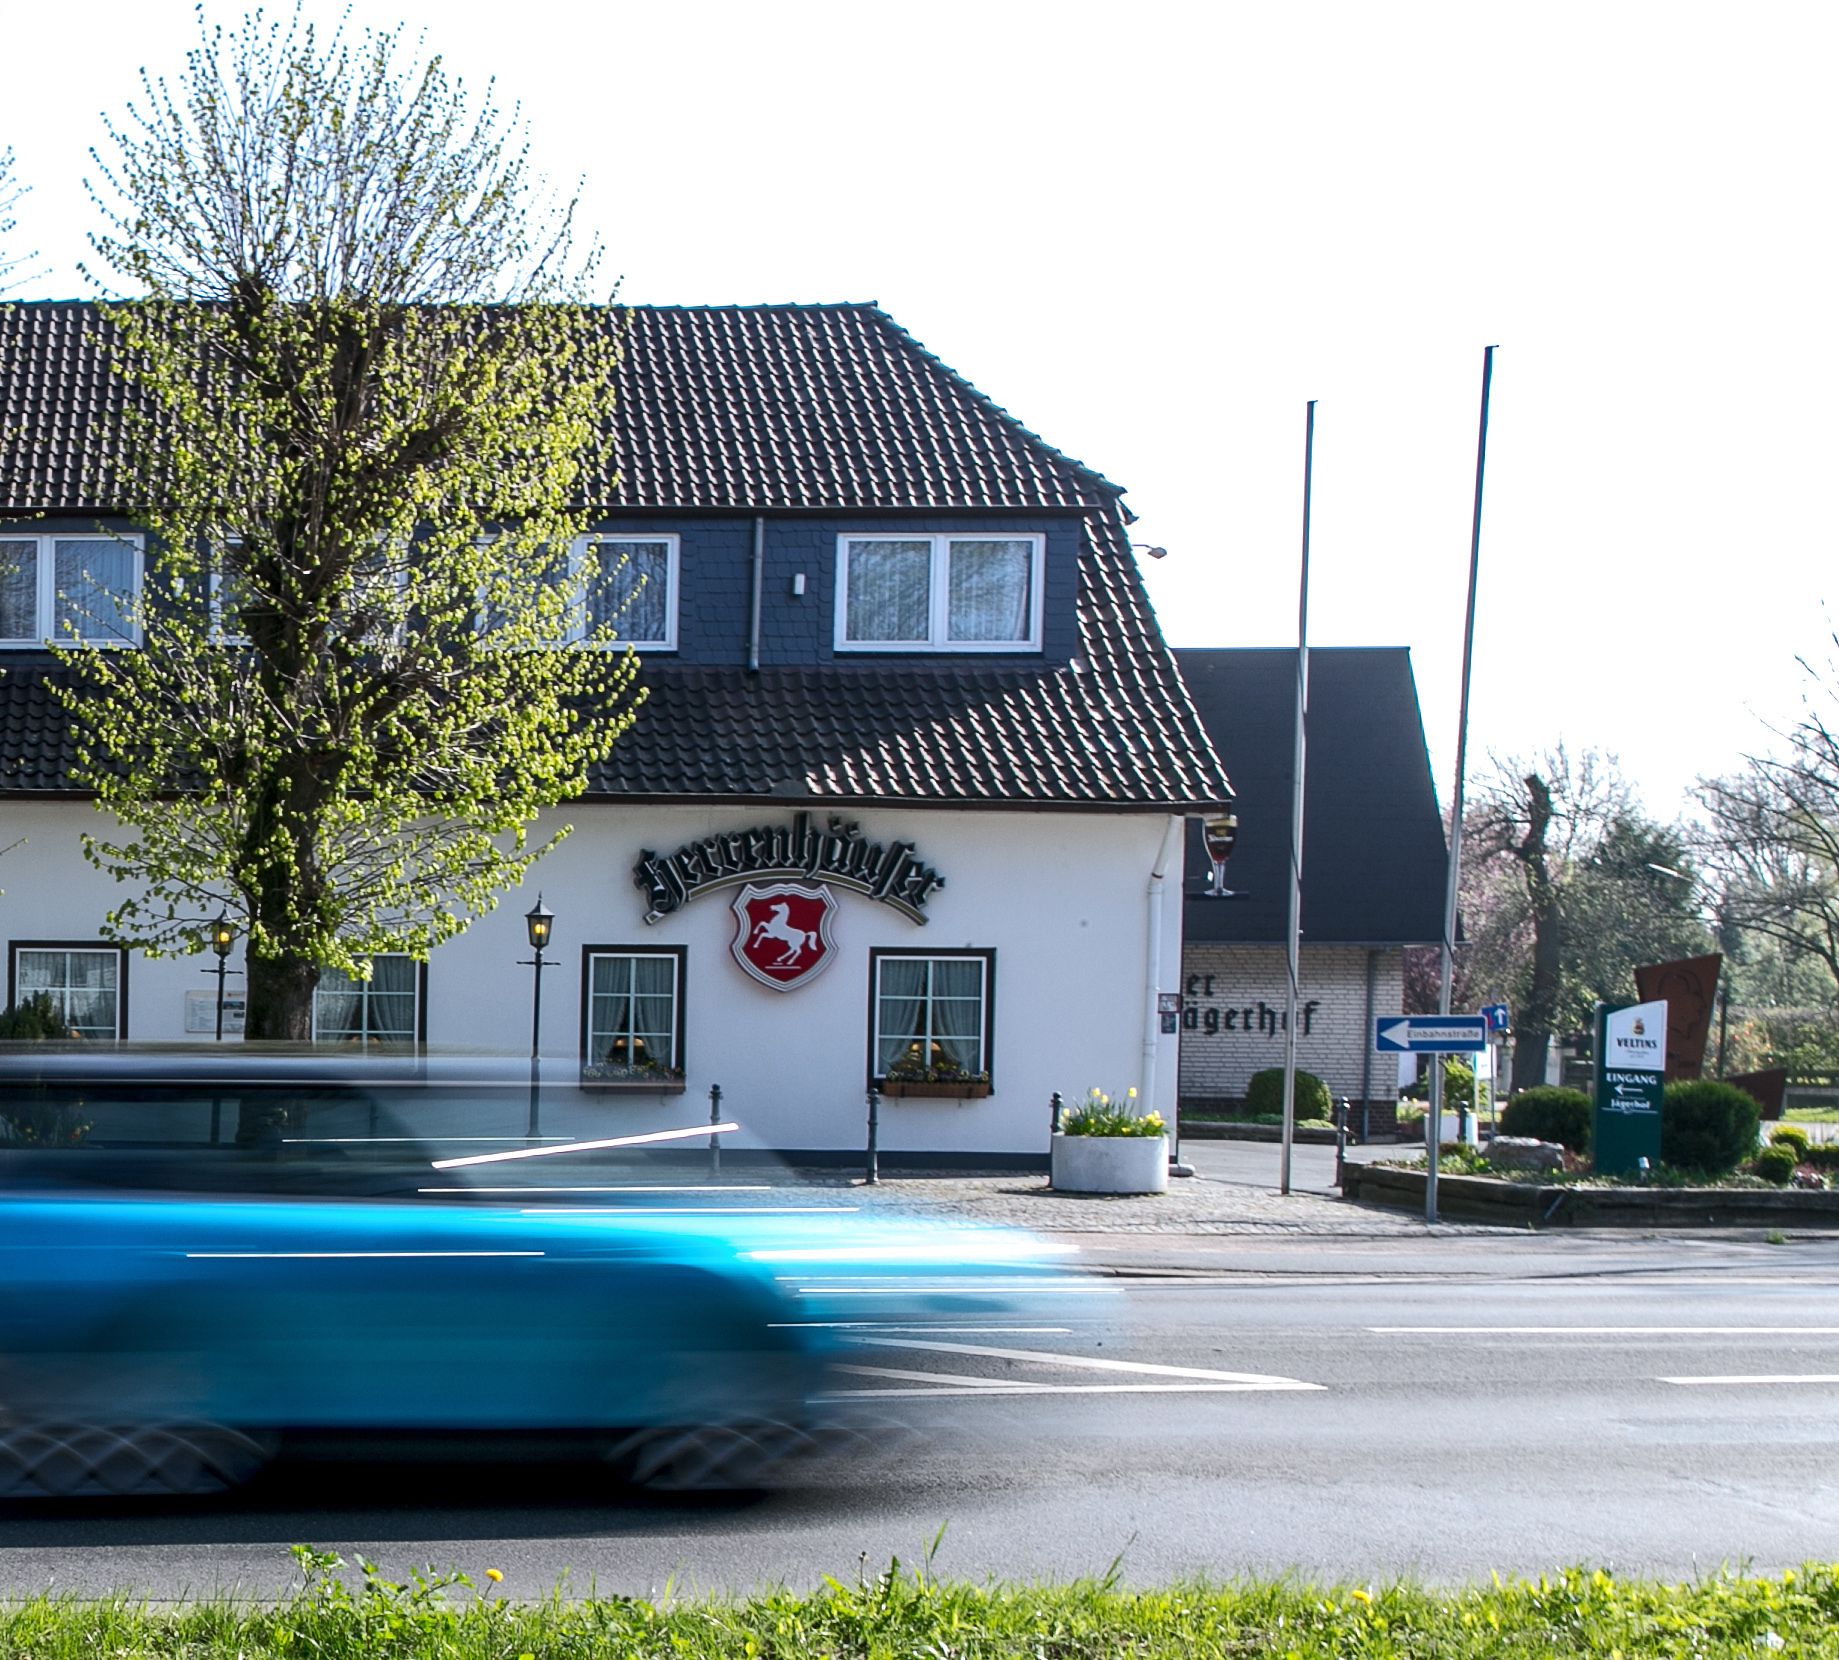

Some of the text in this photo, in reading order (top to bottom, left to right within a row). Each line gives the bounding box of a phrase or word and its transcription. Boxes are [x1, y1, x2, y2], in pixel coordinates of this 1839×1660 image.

[1186, 974, 1216, 996] er
[1182, 1001, 1321, 1037] ägerhf
[1407, 1029, 1479, 1039] Einbahnstraße
[1617, 1037, 1657, 1049] VELTINS
[1606, 1073, 1657, 1085] EINGANG
